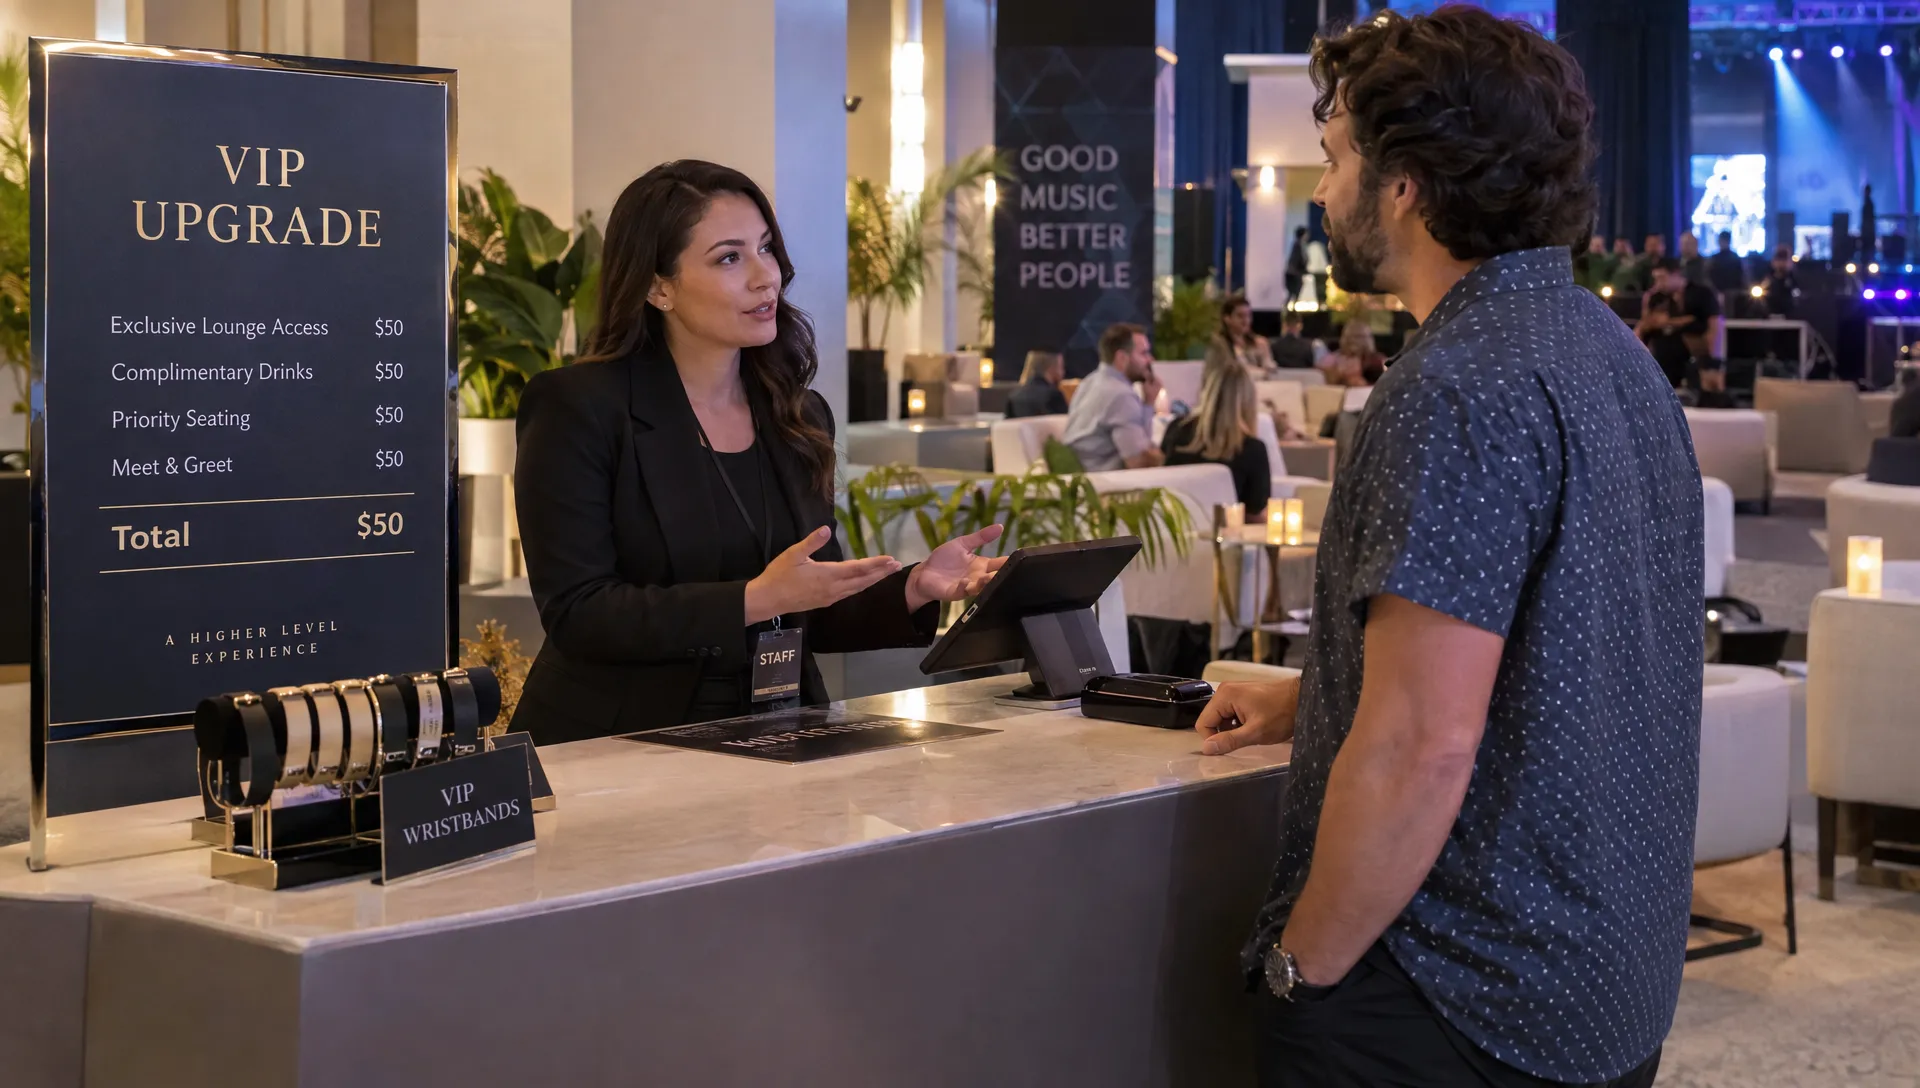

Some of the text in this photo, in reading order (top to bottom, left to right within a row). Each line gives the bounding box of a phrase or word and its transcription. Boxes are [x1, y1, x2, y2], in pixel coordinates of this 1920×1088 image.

[216, 144, 305, 188] VIP
[1020, 144, 1118, 173] GOOD
[1020, 184, 1118, 211] MUSIC
[132, 200, 382, 248] UPGRADE
[1020, 223, 1127, 250] BETTER
[1020, 261, 1131, 289] PEOPLE
[111, 315, 404, 341] Exclusive Lounge Access $50
[111, 360, 404, 386] Complimentary Drinks $50
[112, 404, 404, 433] Priority Seating $50
[112, 448, 404, 477] Meet & Greet $50
[111, 510, 404, 552] Total $50
[165, 619, 338, 646] A HIGHER LEVEL
[191, 641, 319, 665] EXPERIENCE
[760, 649, 796, 666] STAFF
[440, 782, 475, 807] VIP
[402, 799, 520, 846] WRISTBANDS
